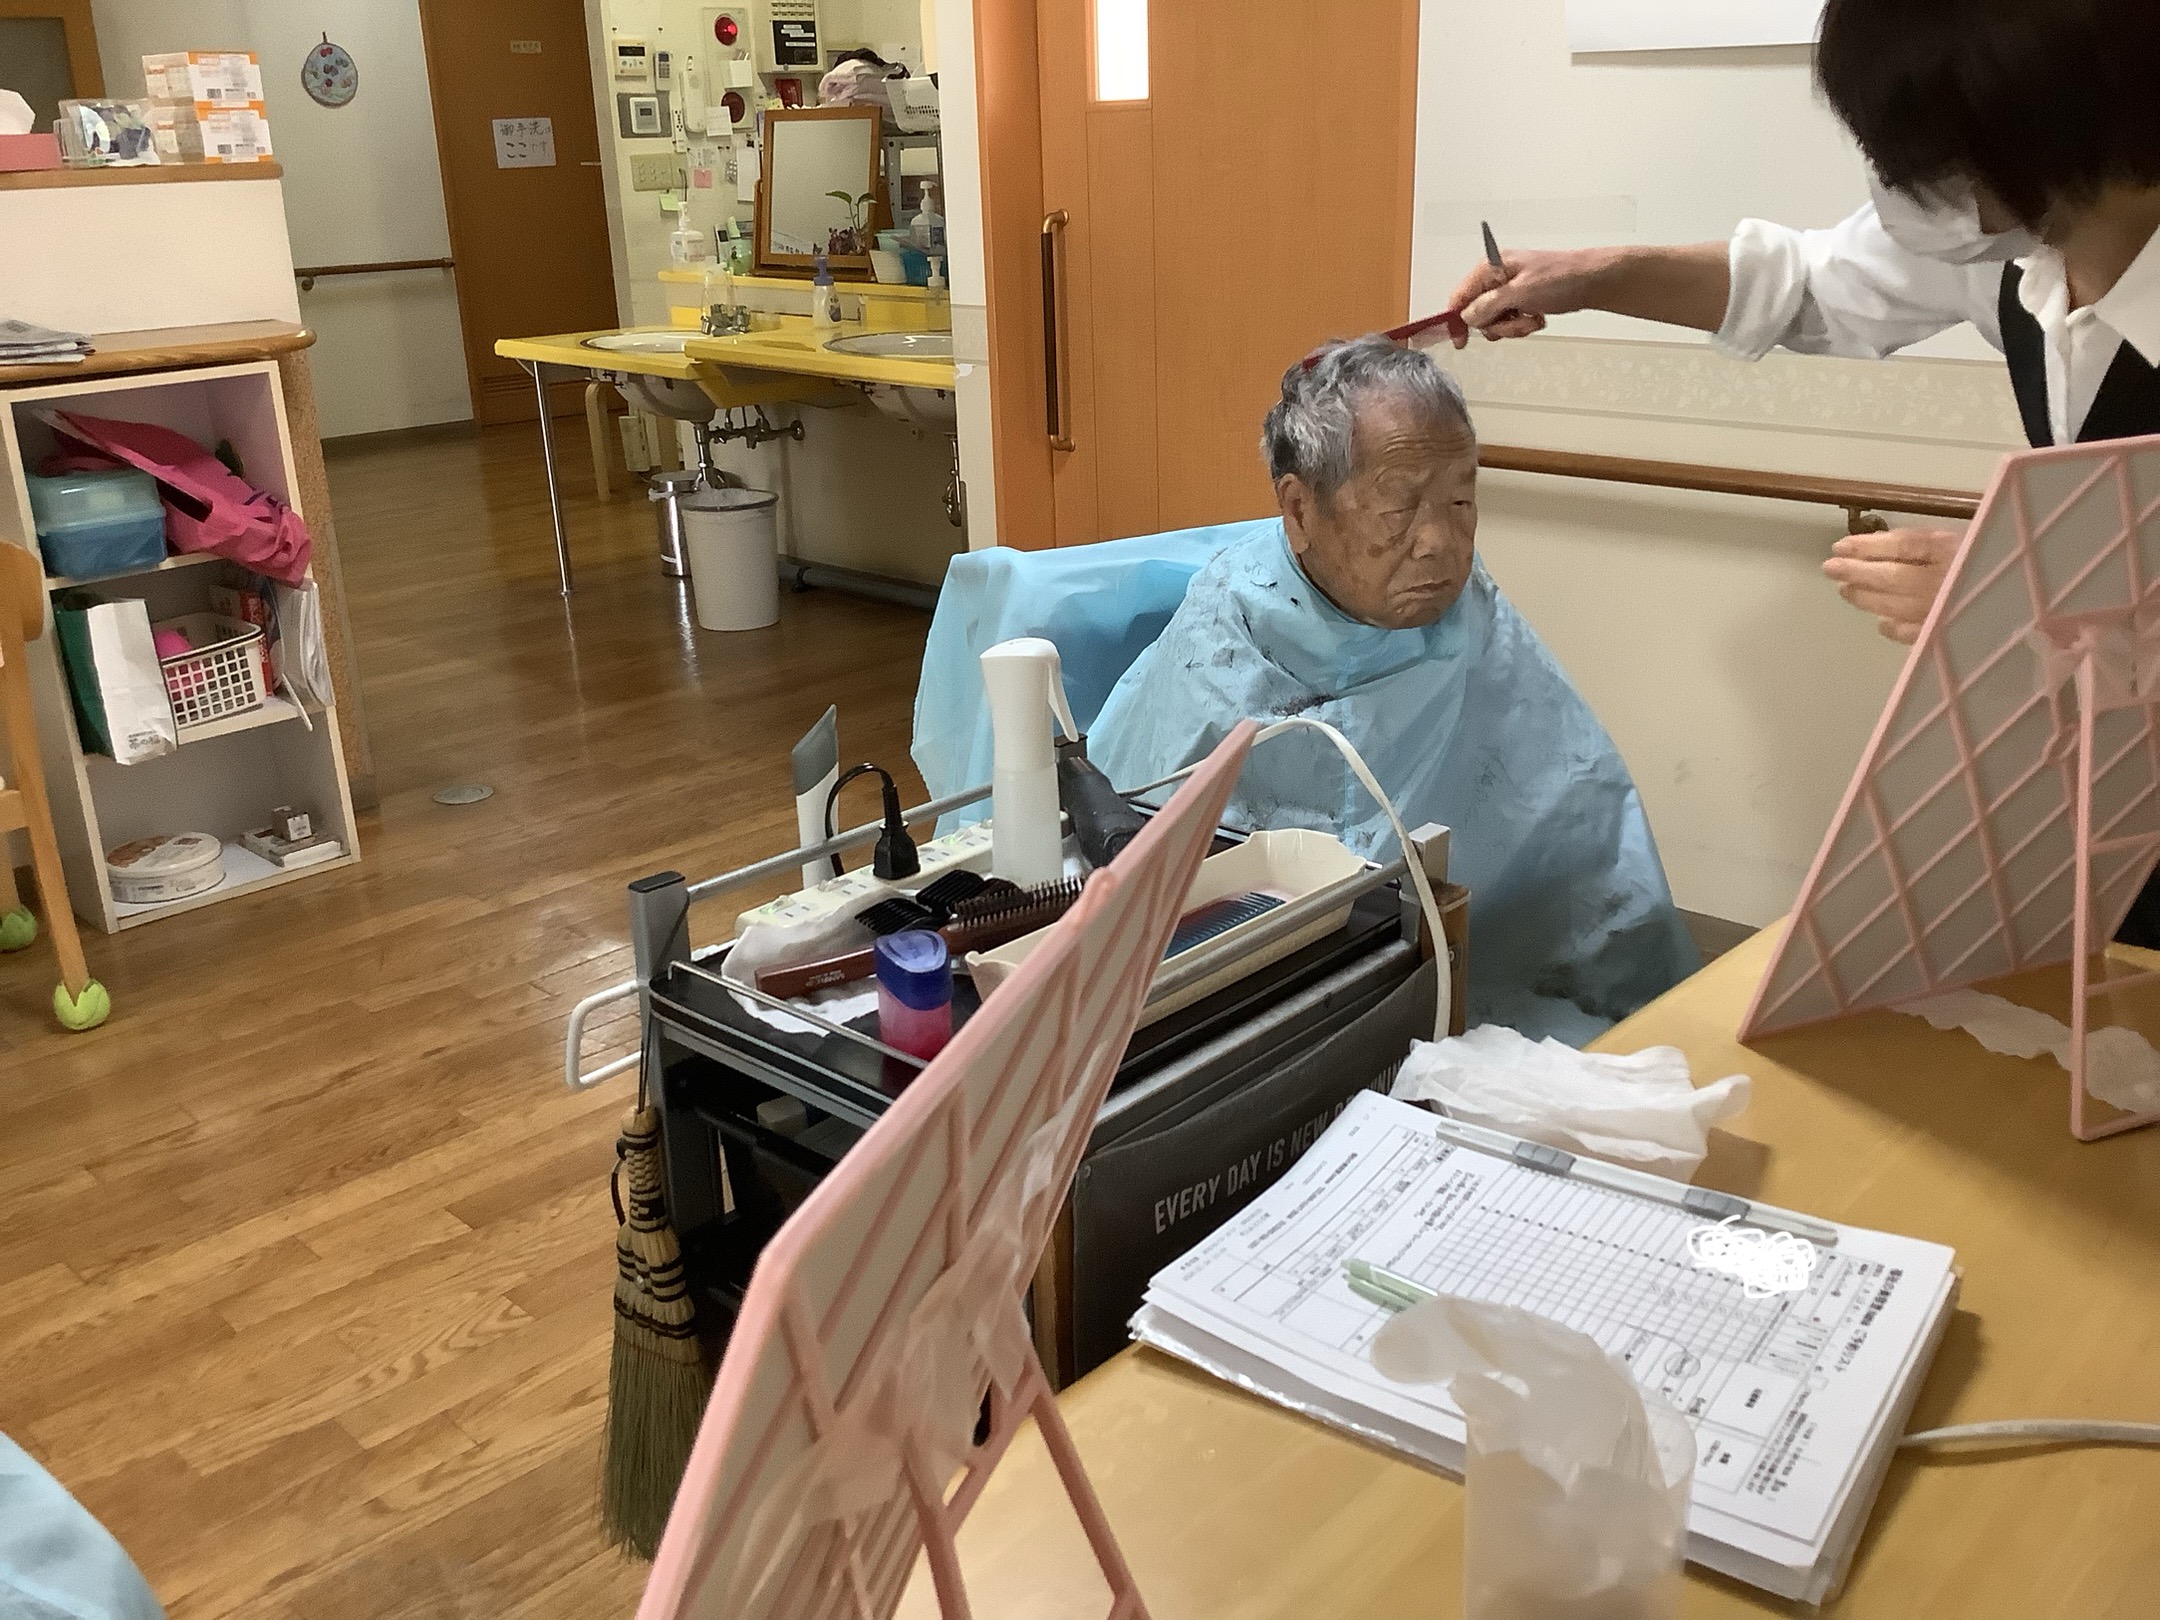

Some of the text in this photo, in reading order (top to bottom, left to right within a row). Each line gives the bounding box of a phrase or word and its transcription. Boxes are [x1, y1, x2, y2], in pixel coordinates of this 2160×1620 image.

[1154, 1174, 1220, 1235] EVERY
[1227, 1151, 1262, 1197] DAY
[1266, 1138, 1286, 1172] IS
[1289, 1110, 1329, 1158] NEW
